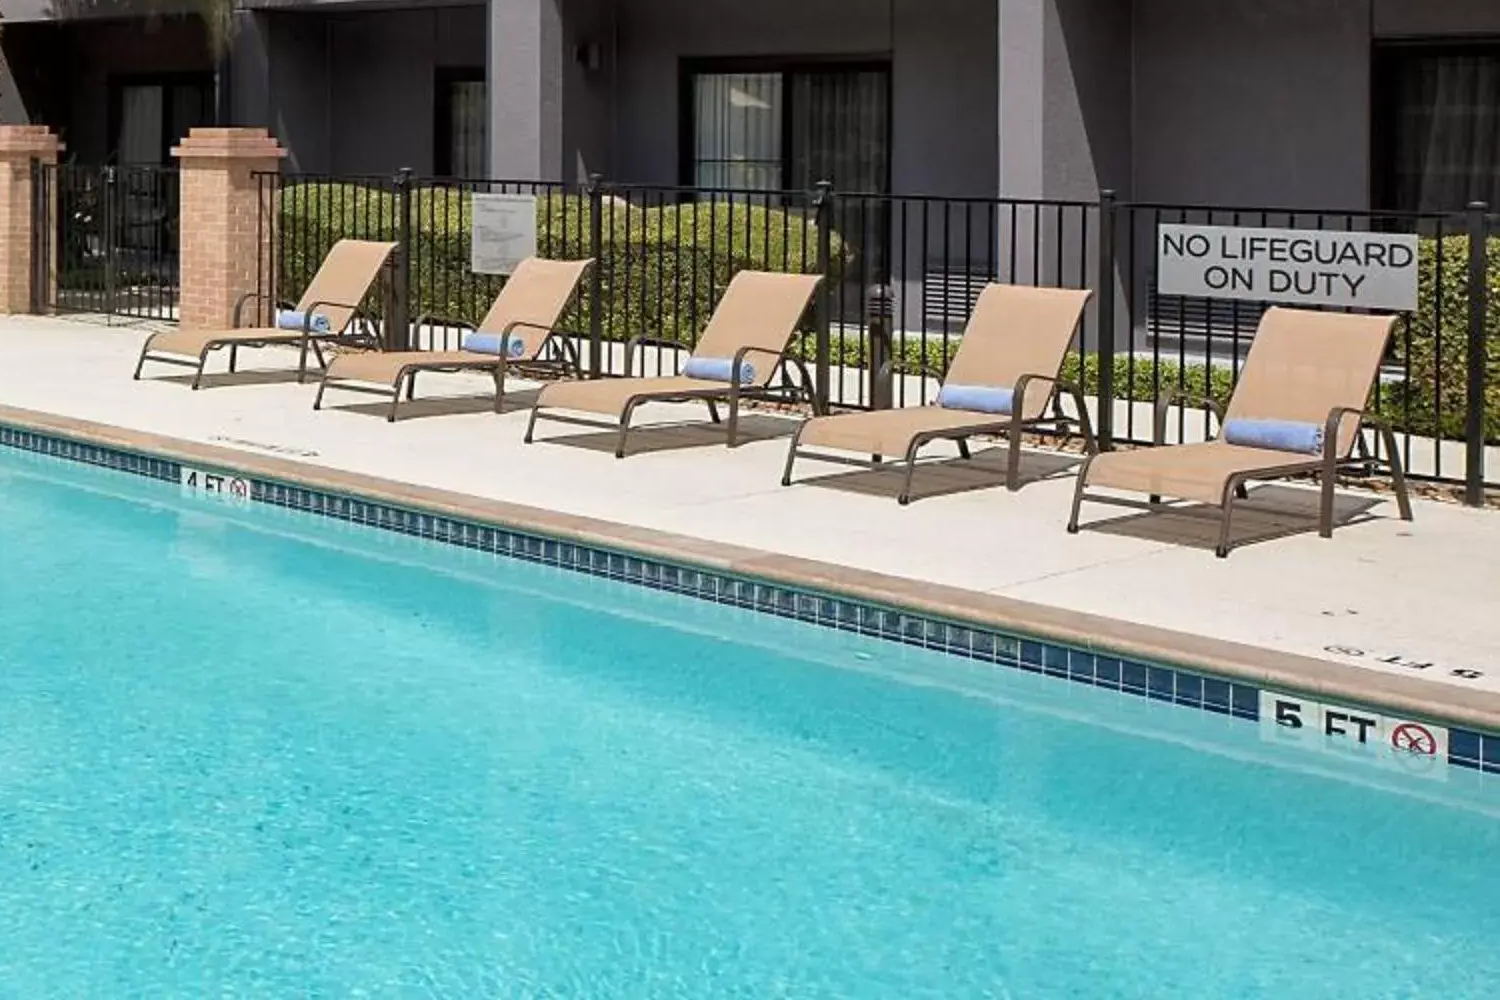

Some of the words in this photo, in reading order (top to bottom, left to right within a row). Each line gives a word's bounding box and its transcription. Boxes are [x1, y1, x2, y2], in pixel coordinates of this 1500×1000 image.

[1163, 233, 1211, 257] NO
[1221, 236, 1414, 268] LIFEGUARD
[1204, 265, 1253, 290] ON
[1269, 269, 1366, 298] DUTY
[185, 471, 197, 488] 4
[205, 473, 225, 493] FT
[1275, 699, 1303, 729] 5
[1325, 710, 1377, 745] FT
